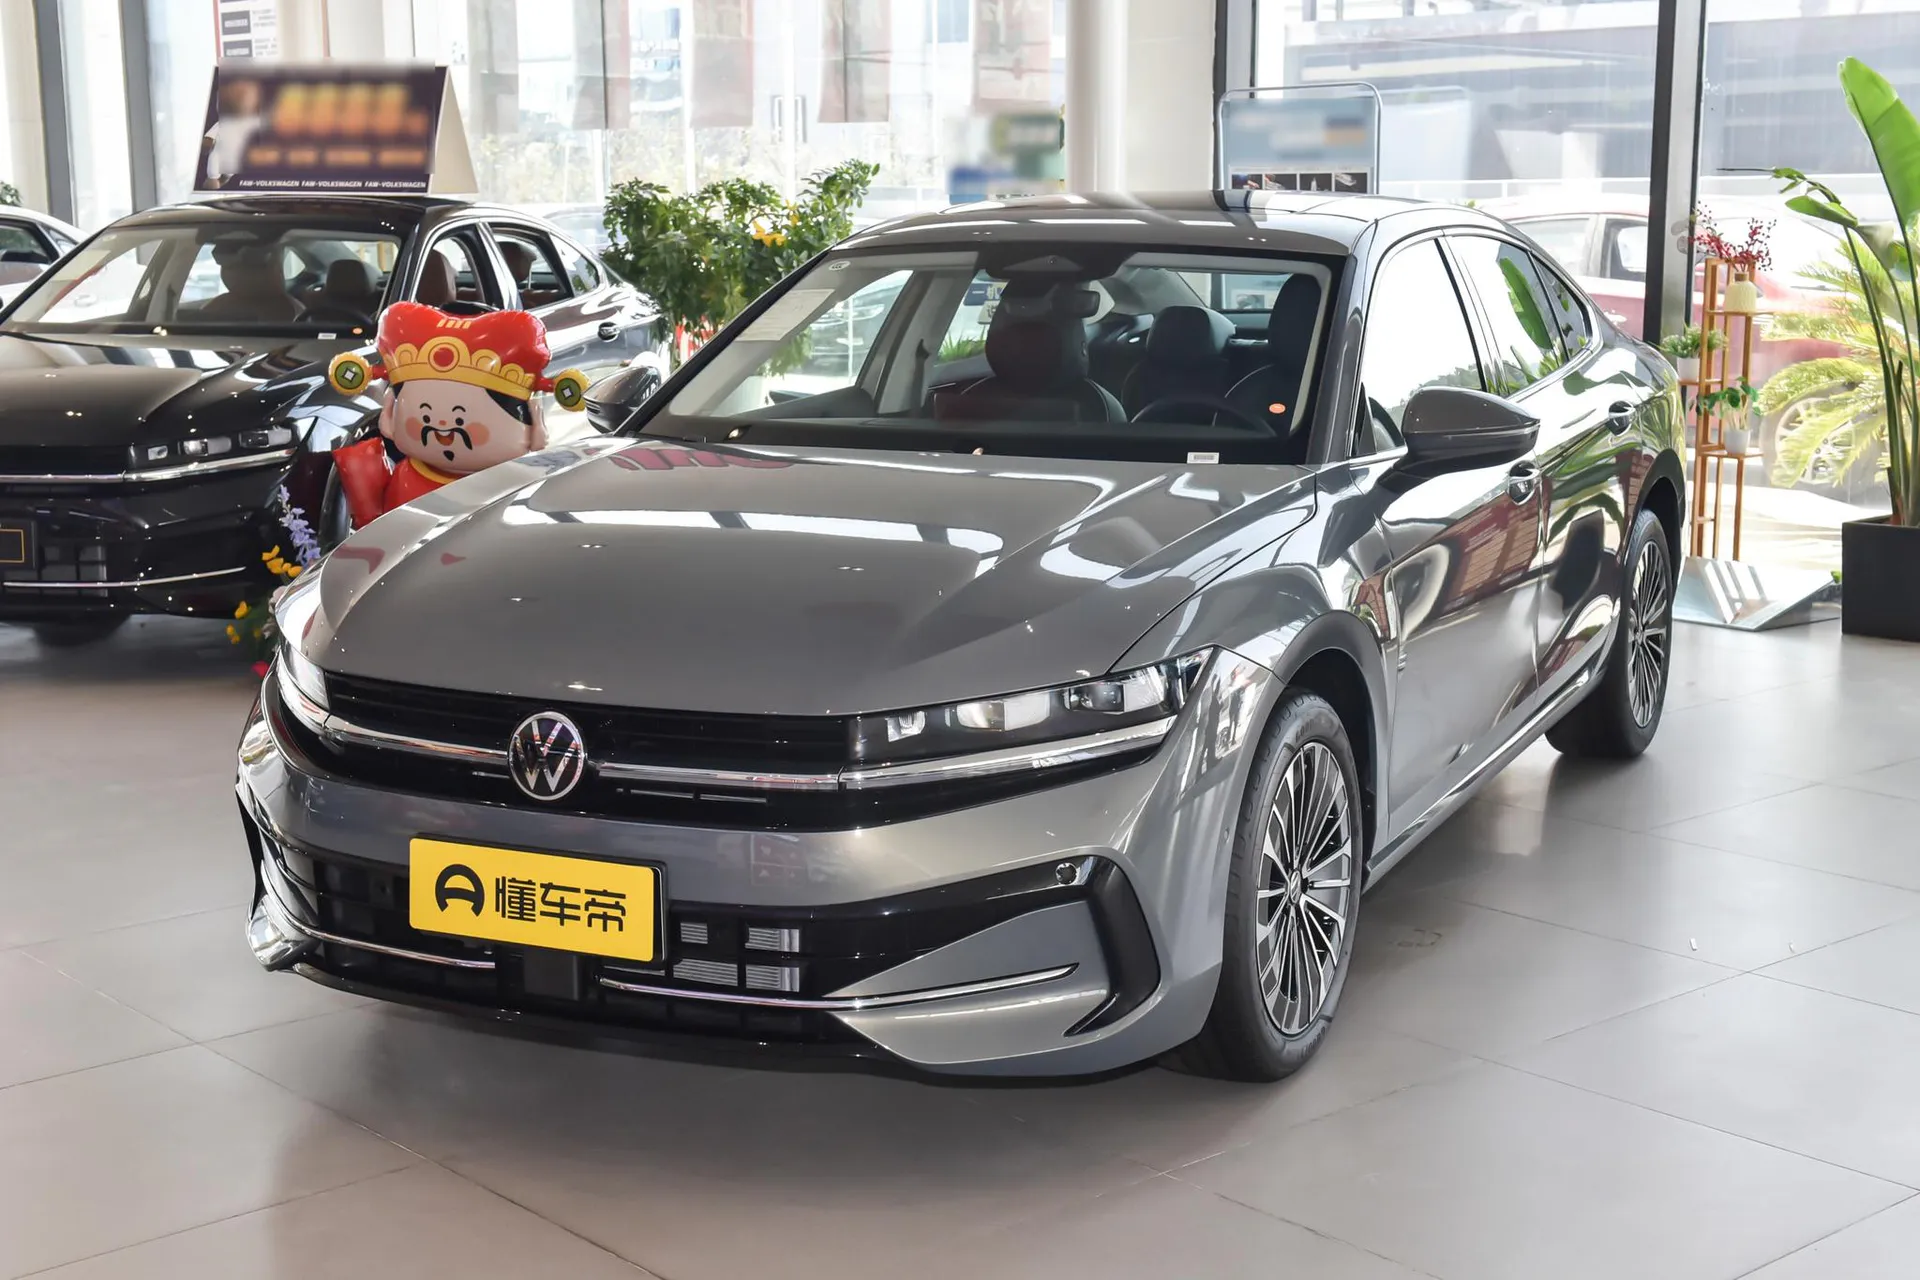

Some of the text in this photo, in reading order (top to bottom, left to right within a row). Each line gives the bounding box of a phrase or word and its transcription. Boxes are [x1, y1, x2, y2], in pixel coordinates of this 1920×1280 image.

[239, 179, 426, 189] FAW-VOLKSWAGEN FAW-VOLKSWAGEN FAW-VOLKSWAGEN
[495, 876, 627, 933] 懂车帝
